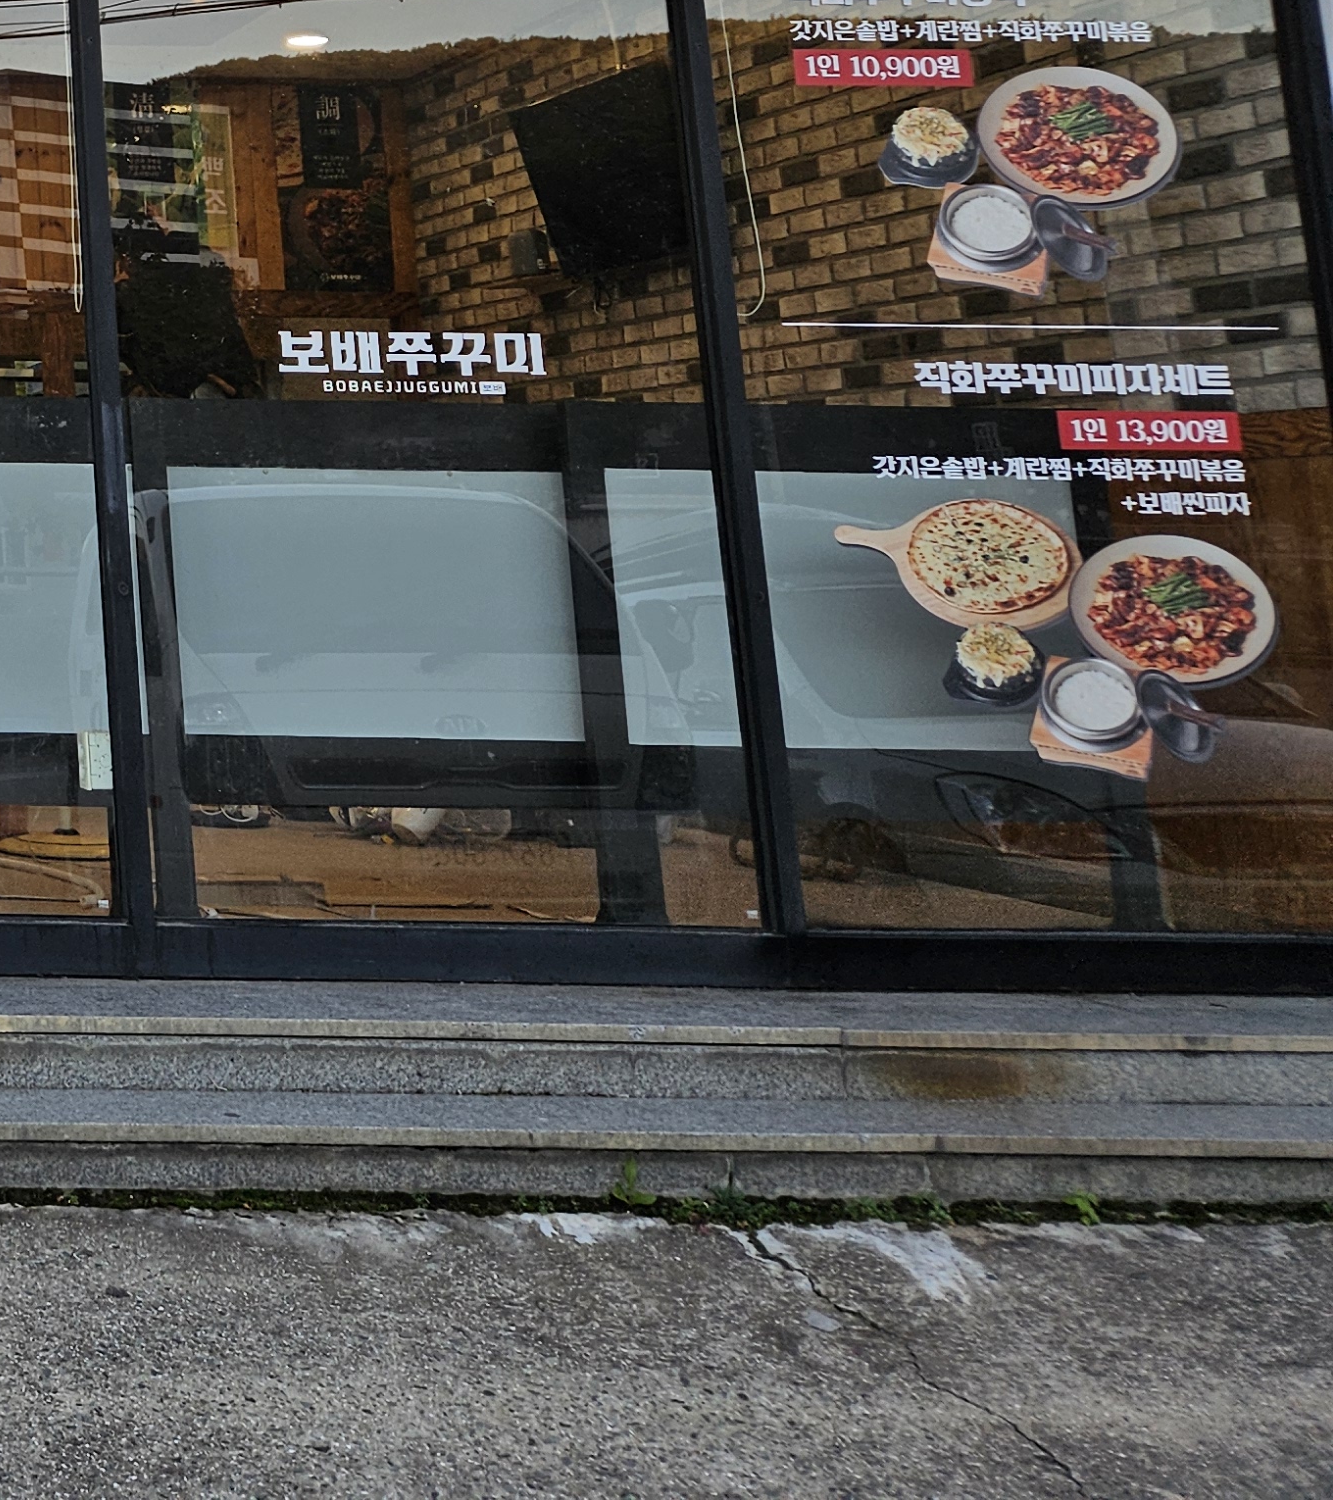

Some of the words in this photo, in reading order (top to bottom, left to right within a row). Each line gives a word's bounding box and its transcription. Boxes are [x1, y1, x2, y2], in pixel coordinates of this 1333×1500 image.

[806, 54, 841, 78] 1인
[850, 54, 961, 80] 10,900원
[278, 330, 548, 377] 보배쭈꾸미
[322, 380, 478, 393] BOBAEJJUGGUMI
[913, 361, 1234, 396] 직화쭈꾸미피자세트
[1069, 418, 1108, 444] 1인
[1117, 418, 1229, 445] 13,900원
